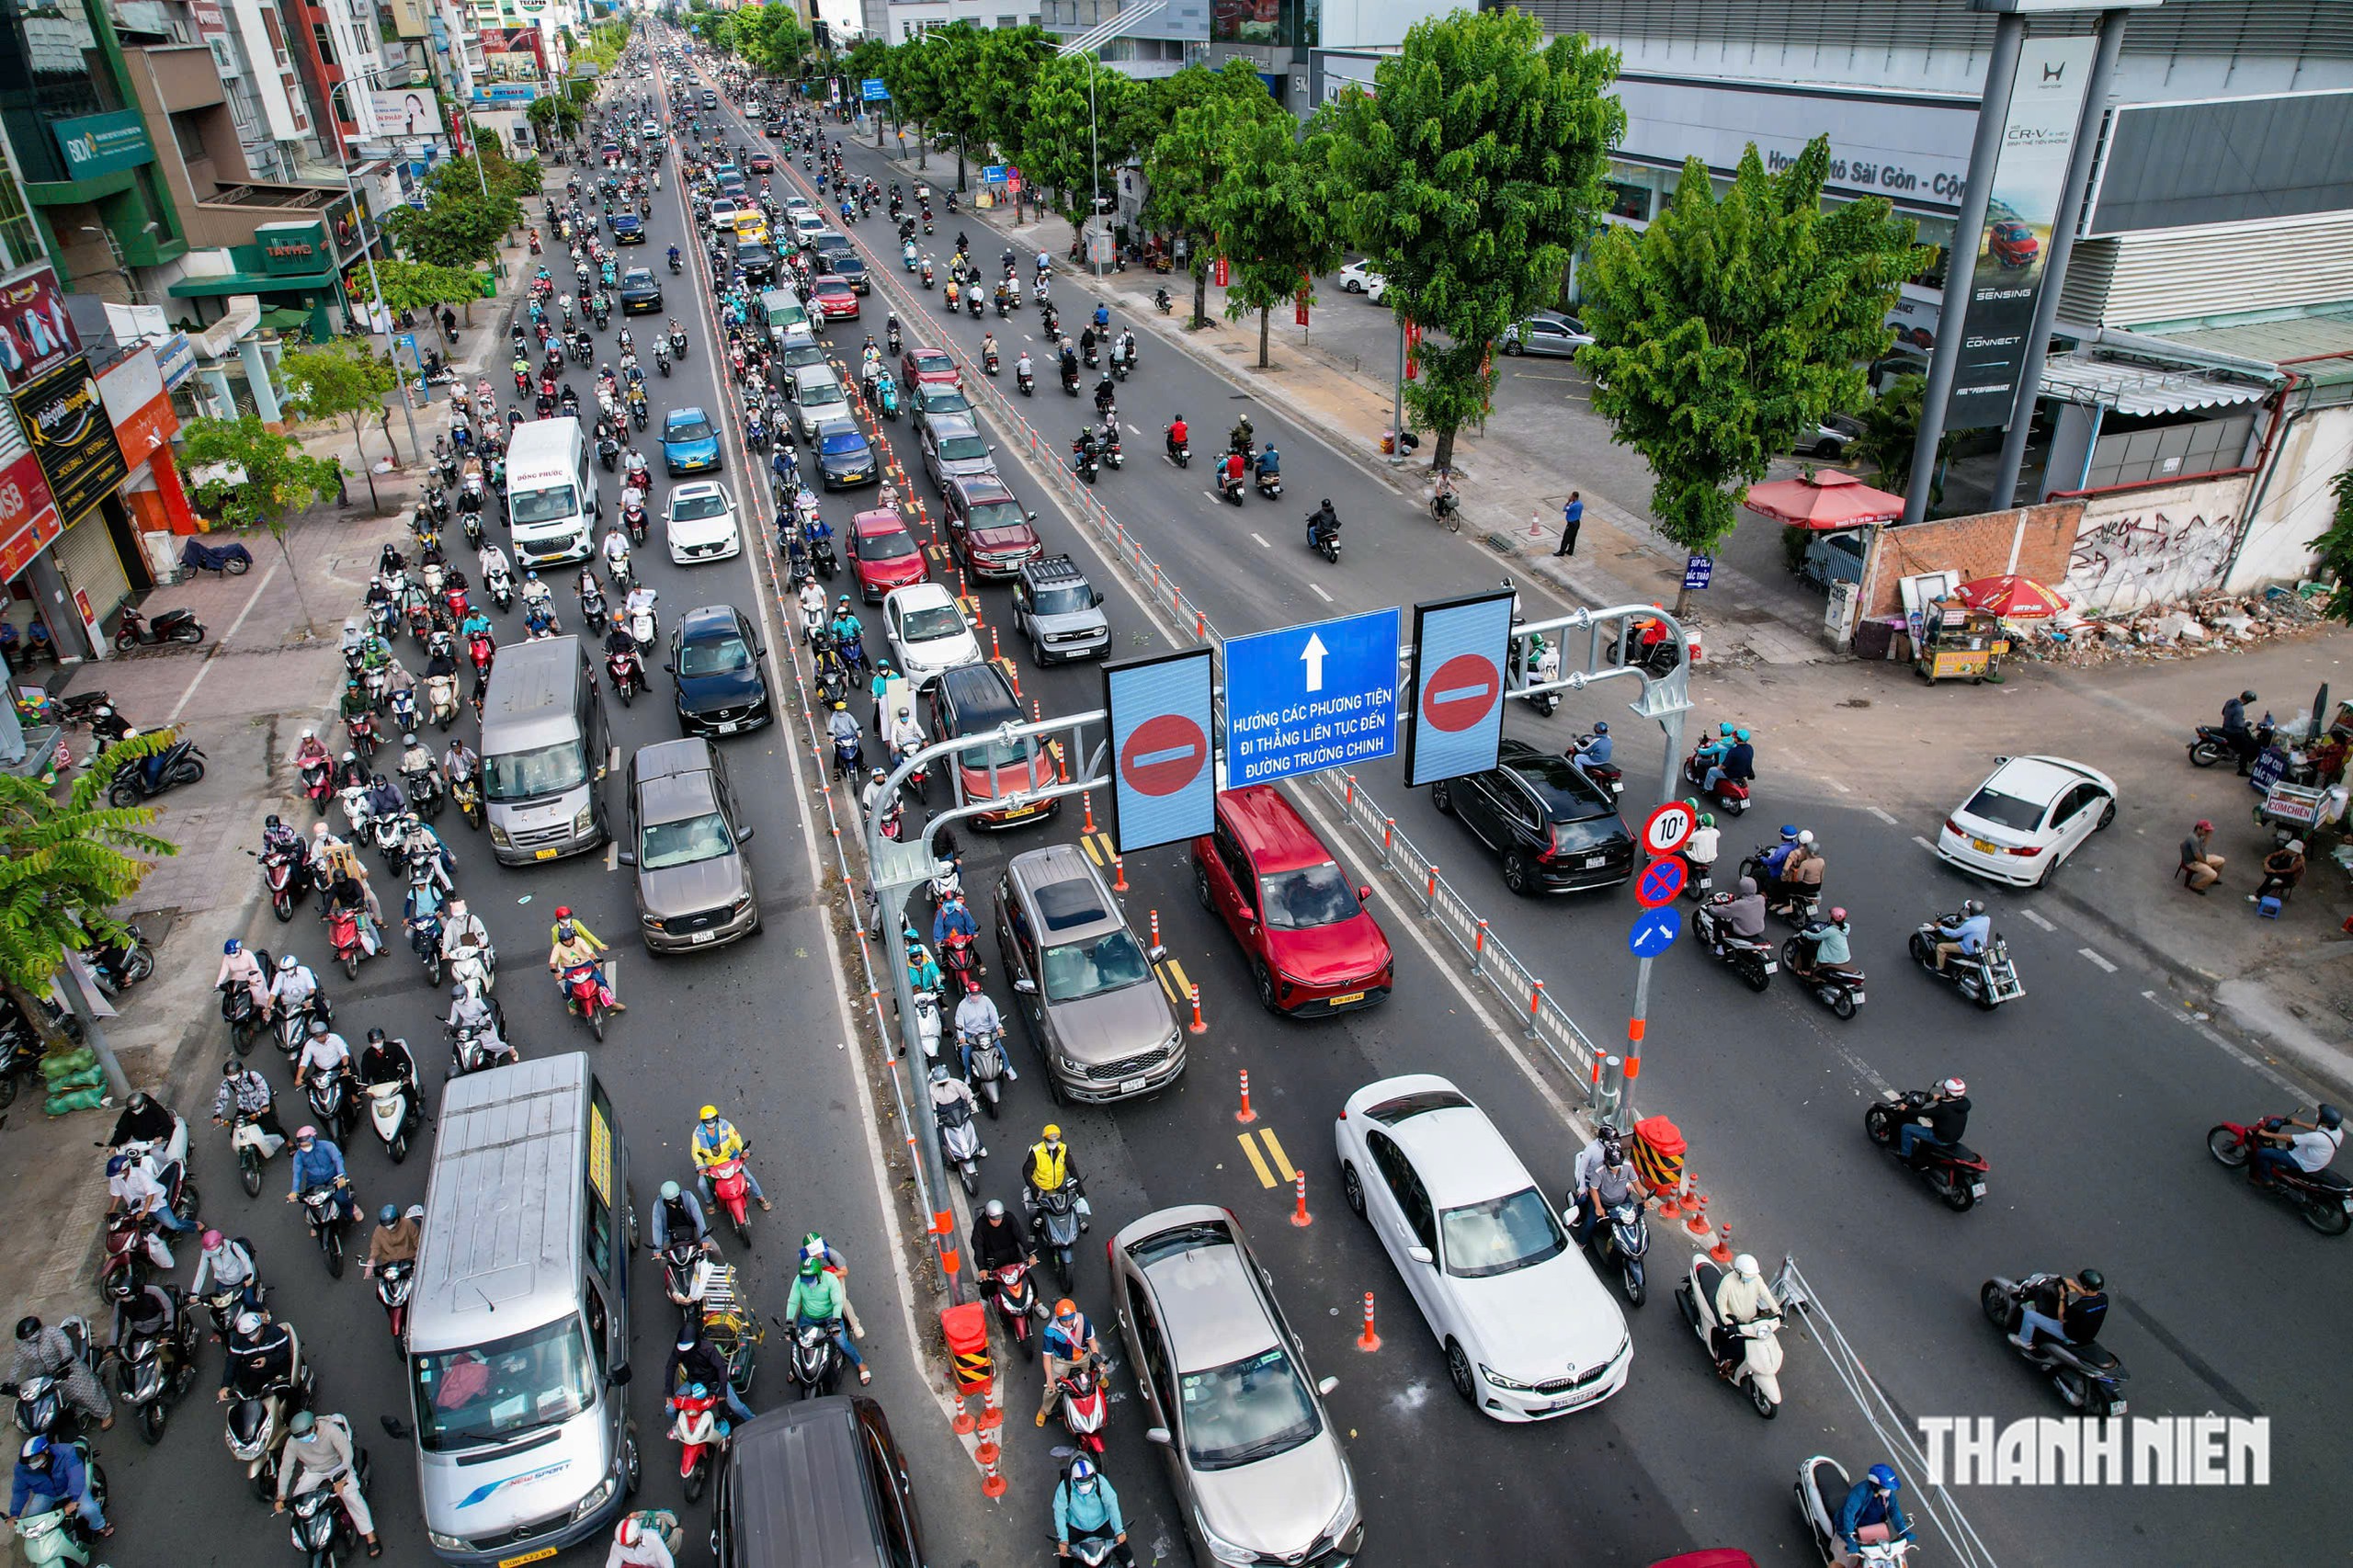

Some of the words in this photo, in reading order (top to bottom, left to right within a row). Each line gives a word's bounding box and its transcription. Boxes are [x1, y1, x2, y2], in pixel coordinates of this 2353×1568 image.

[2008, 129, 2048, 140] CR-V
[1850, 162, 1878, 185] Sài
[1881, 165, 1917, 190] Gòn
[1976, 289, 2031, 301] SENSING
[1967, 336, 2021, 347] CONNECT
[1233, 710, 1279, 733] HƯỚNG
[1282, 703, 1307, 723] CÁC
[1310, 694, 1362, 719] PHƯƠNG
[1364, 687, 1392, 708] TIỆN
[1240, 740, 1253, 756] ĐI
[1256, 727, 1300, 753] THẲNG
[1302, 723, 1331, 744] LIÊN
[1334, 719, 1358, 738] TỤC
[1360, 710, 1385, 733] ĐẾN
[1245, 756, 1290, 778] ĐƯỜNG
[1293, 744, 1344, 768] TRƯỜNG
[1347, 736, 1384, 756] CHINH
[510, 1476, 533, 1486] NEW
[535, 1464, 569, 1478] SPORT
